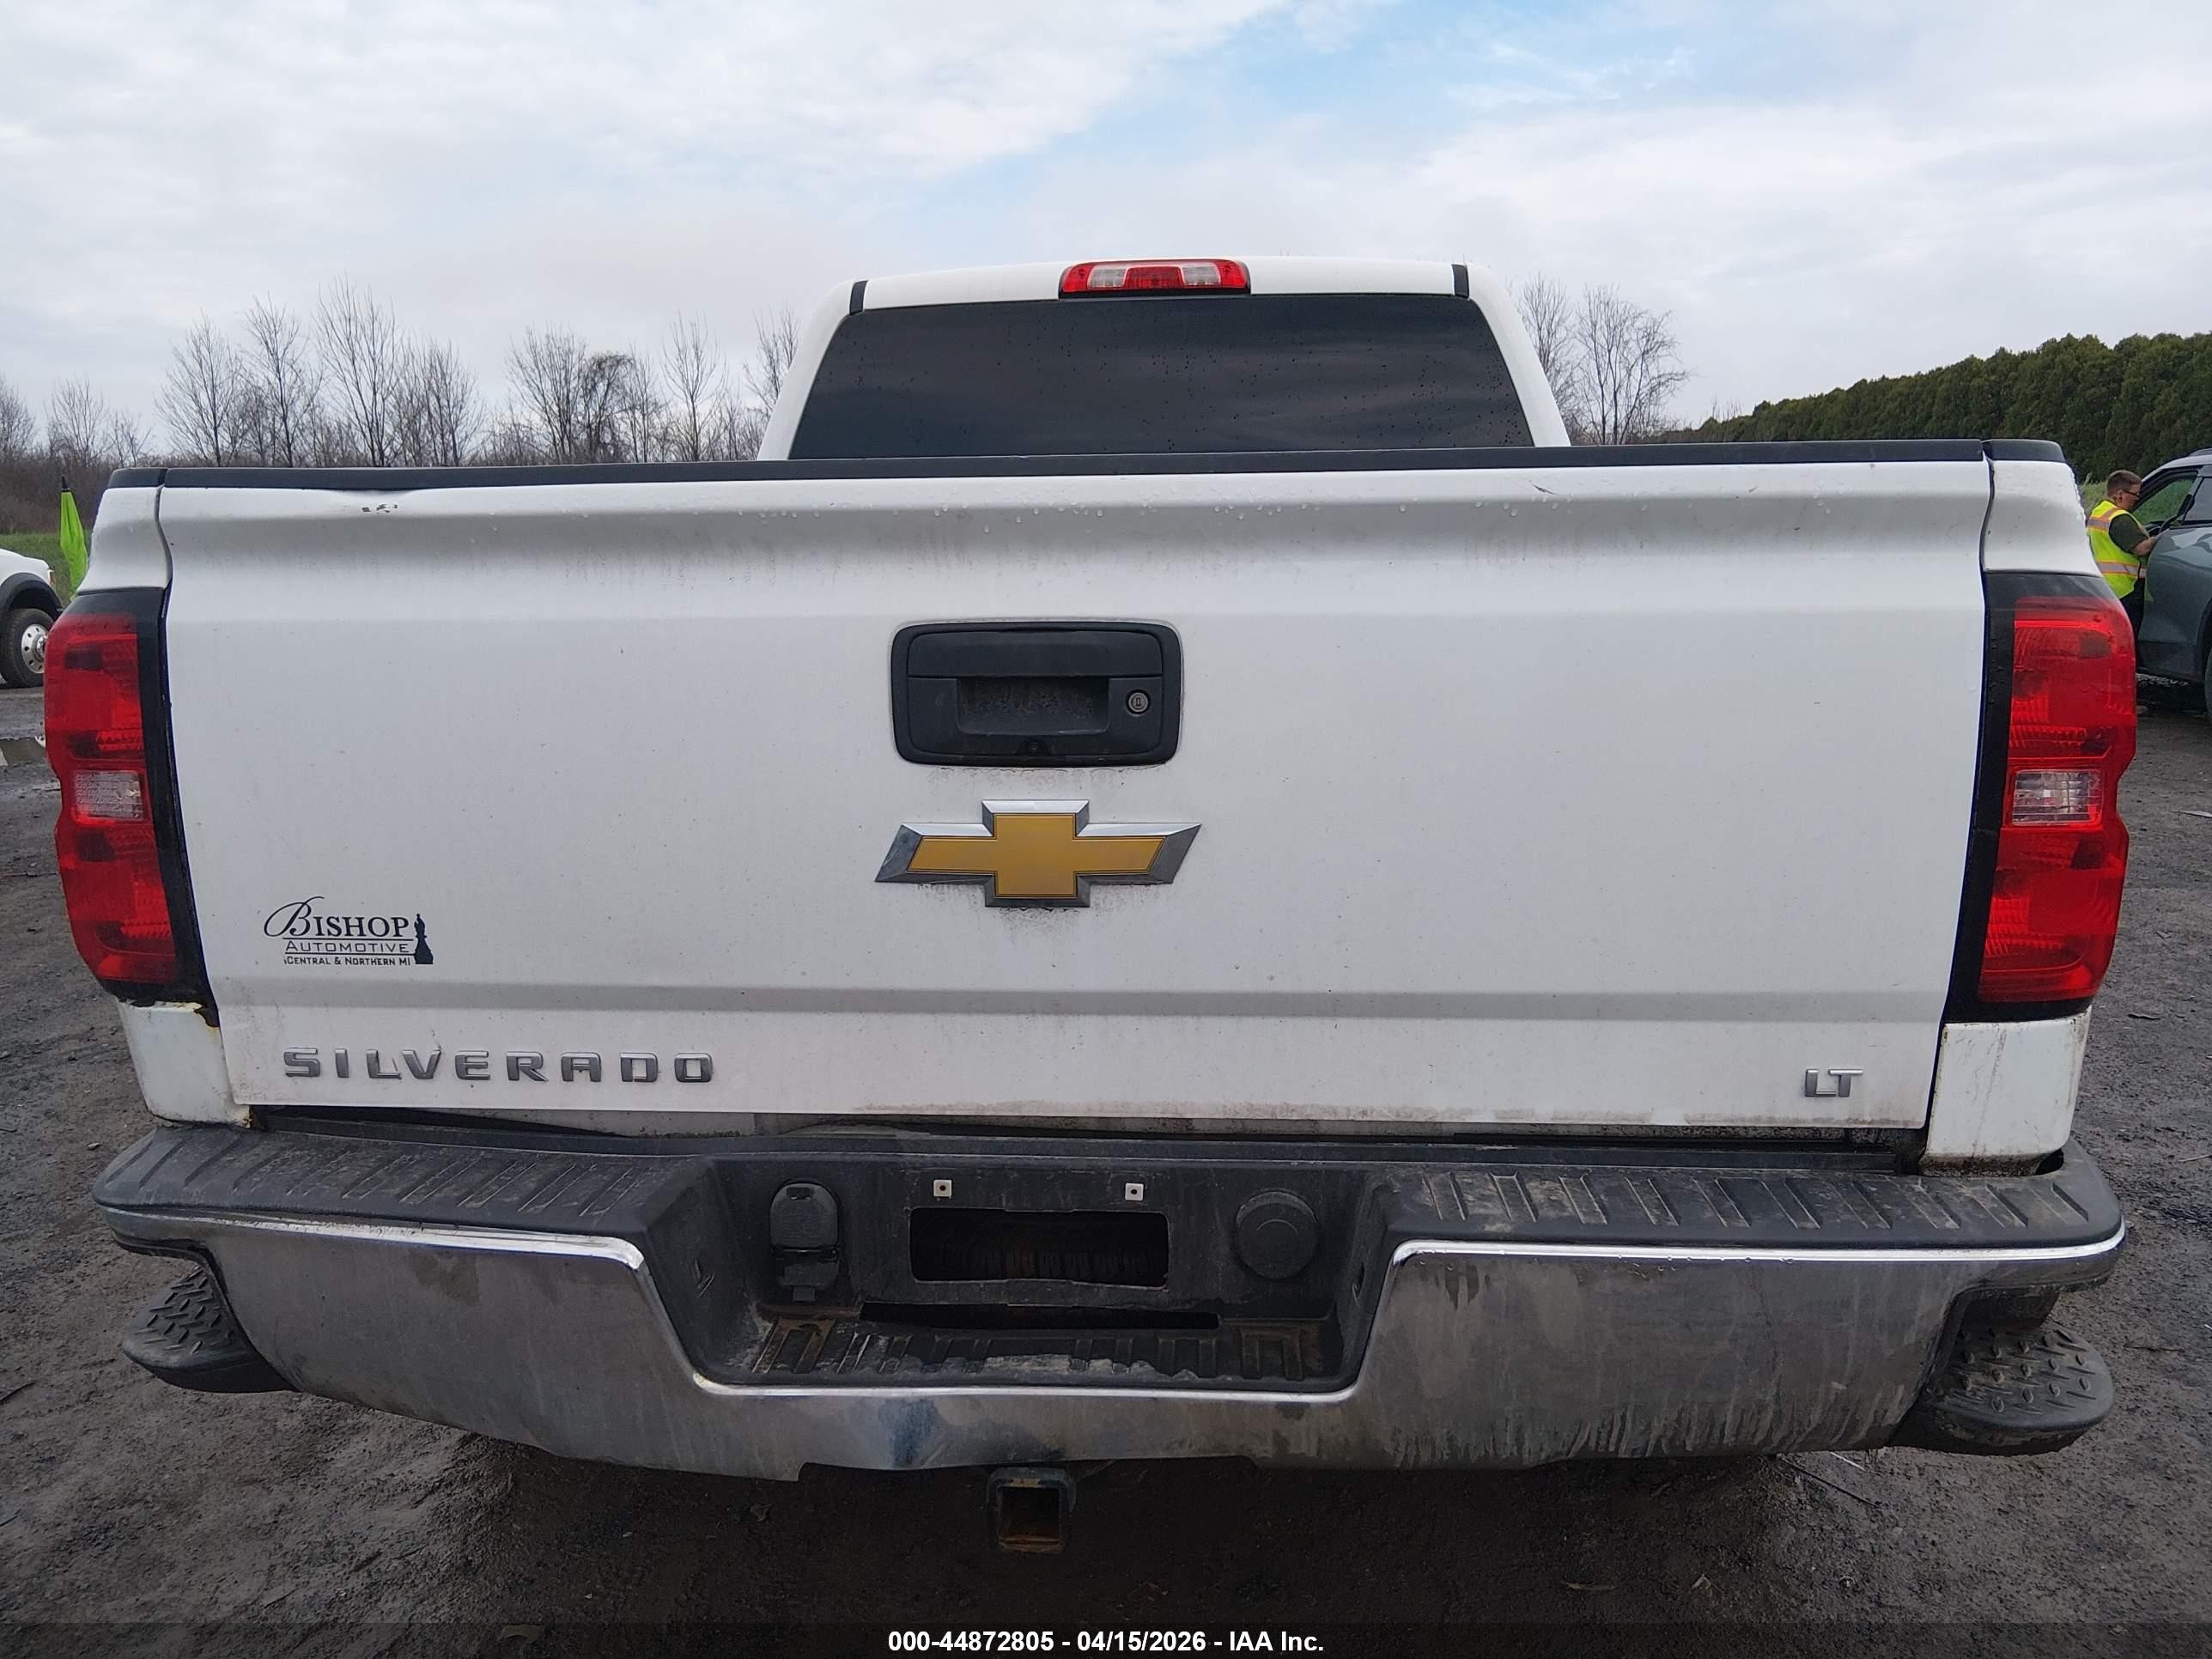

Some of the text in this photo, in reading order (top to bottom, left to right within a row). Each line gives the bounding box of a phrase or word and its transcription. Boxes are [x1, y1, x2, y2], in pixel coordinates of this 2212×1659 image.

[263, 896, 410, 938] BISHOP
[285, 940, 410, 953] AUTOMOTIVE
[334, 957, 342, 965] &
[344, 957, 396, 966] NORTHERN
[283, 1048, 714, 1083] SILVERADO
[1804, 1069, 1863, 1097] LT
